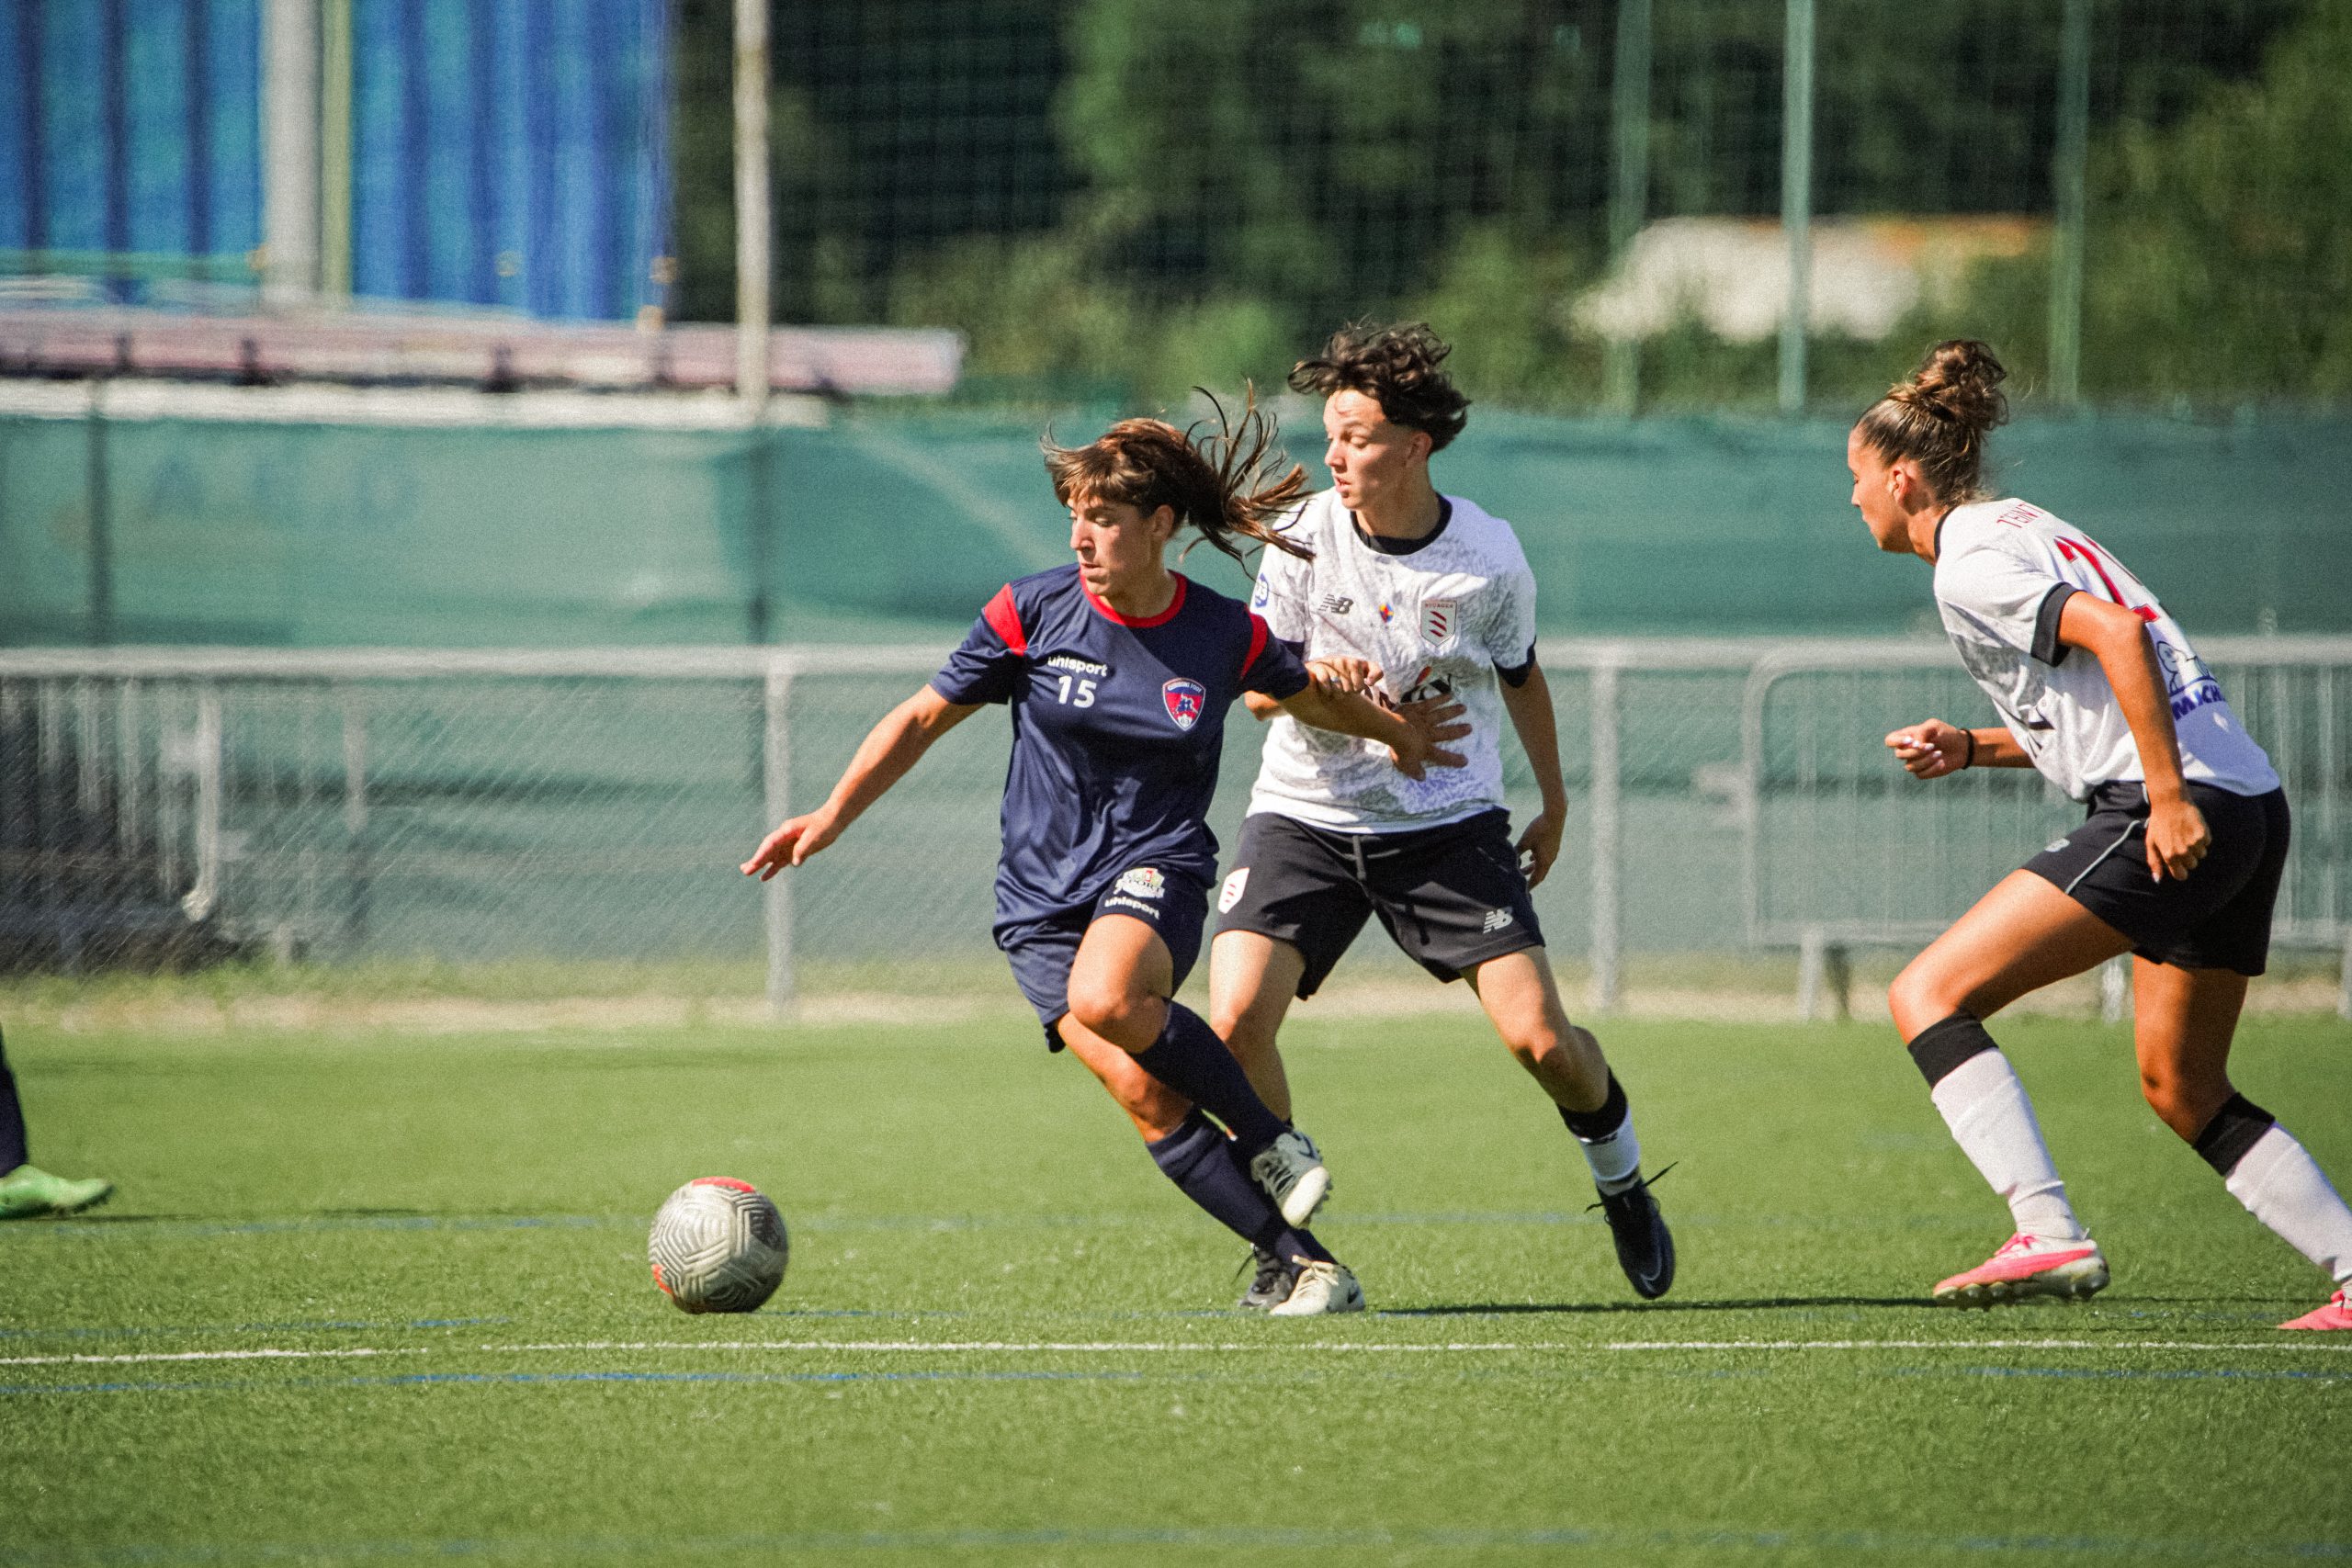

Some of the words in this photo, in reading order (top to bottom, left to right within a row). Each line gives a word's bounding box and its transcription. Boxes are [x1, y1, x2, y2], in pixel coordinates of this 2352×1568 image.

[1047, 655, 1108, 678] uhlsport
[1058, 675, 1097, 708] 15
[2170, 684, 2226, 721] MICH
[1104, 897, 1160, 920] uhlsport
